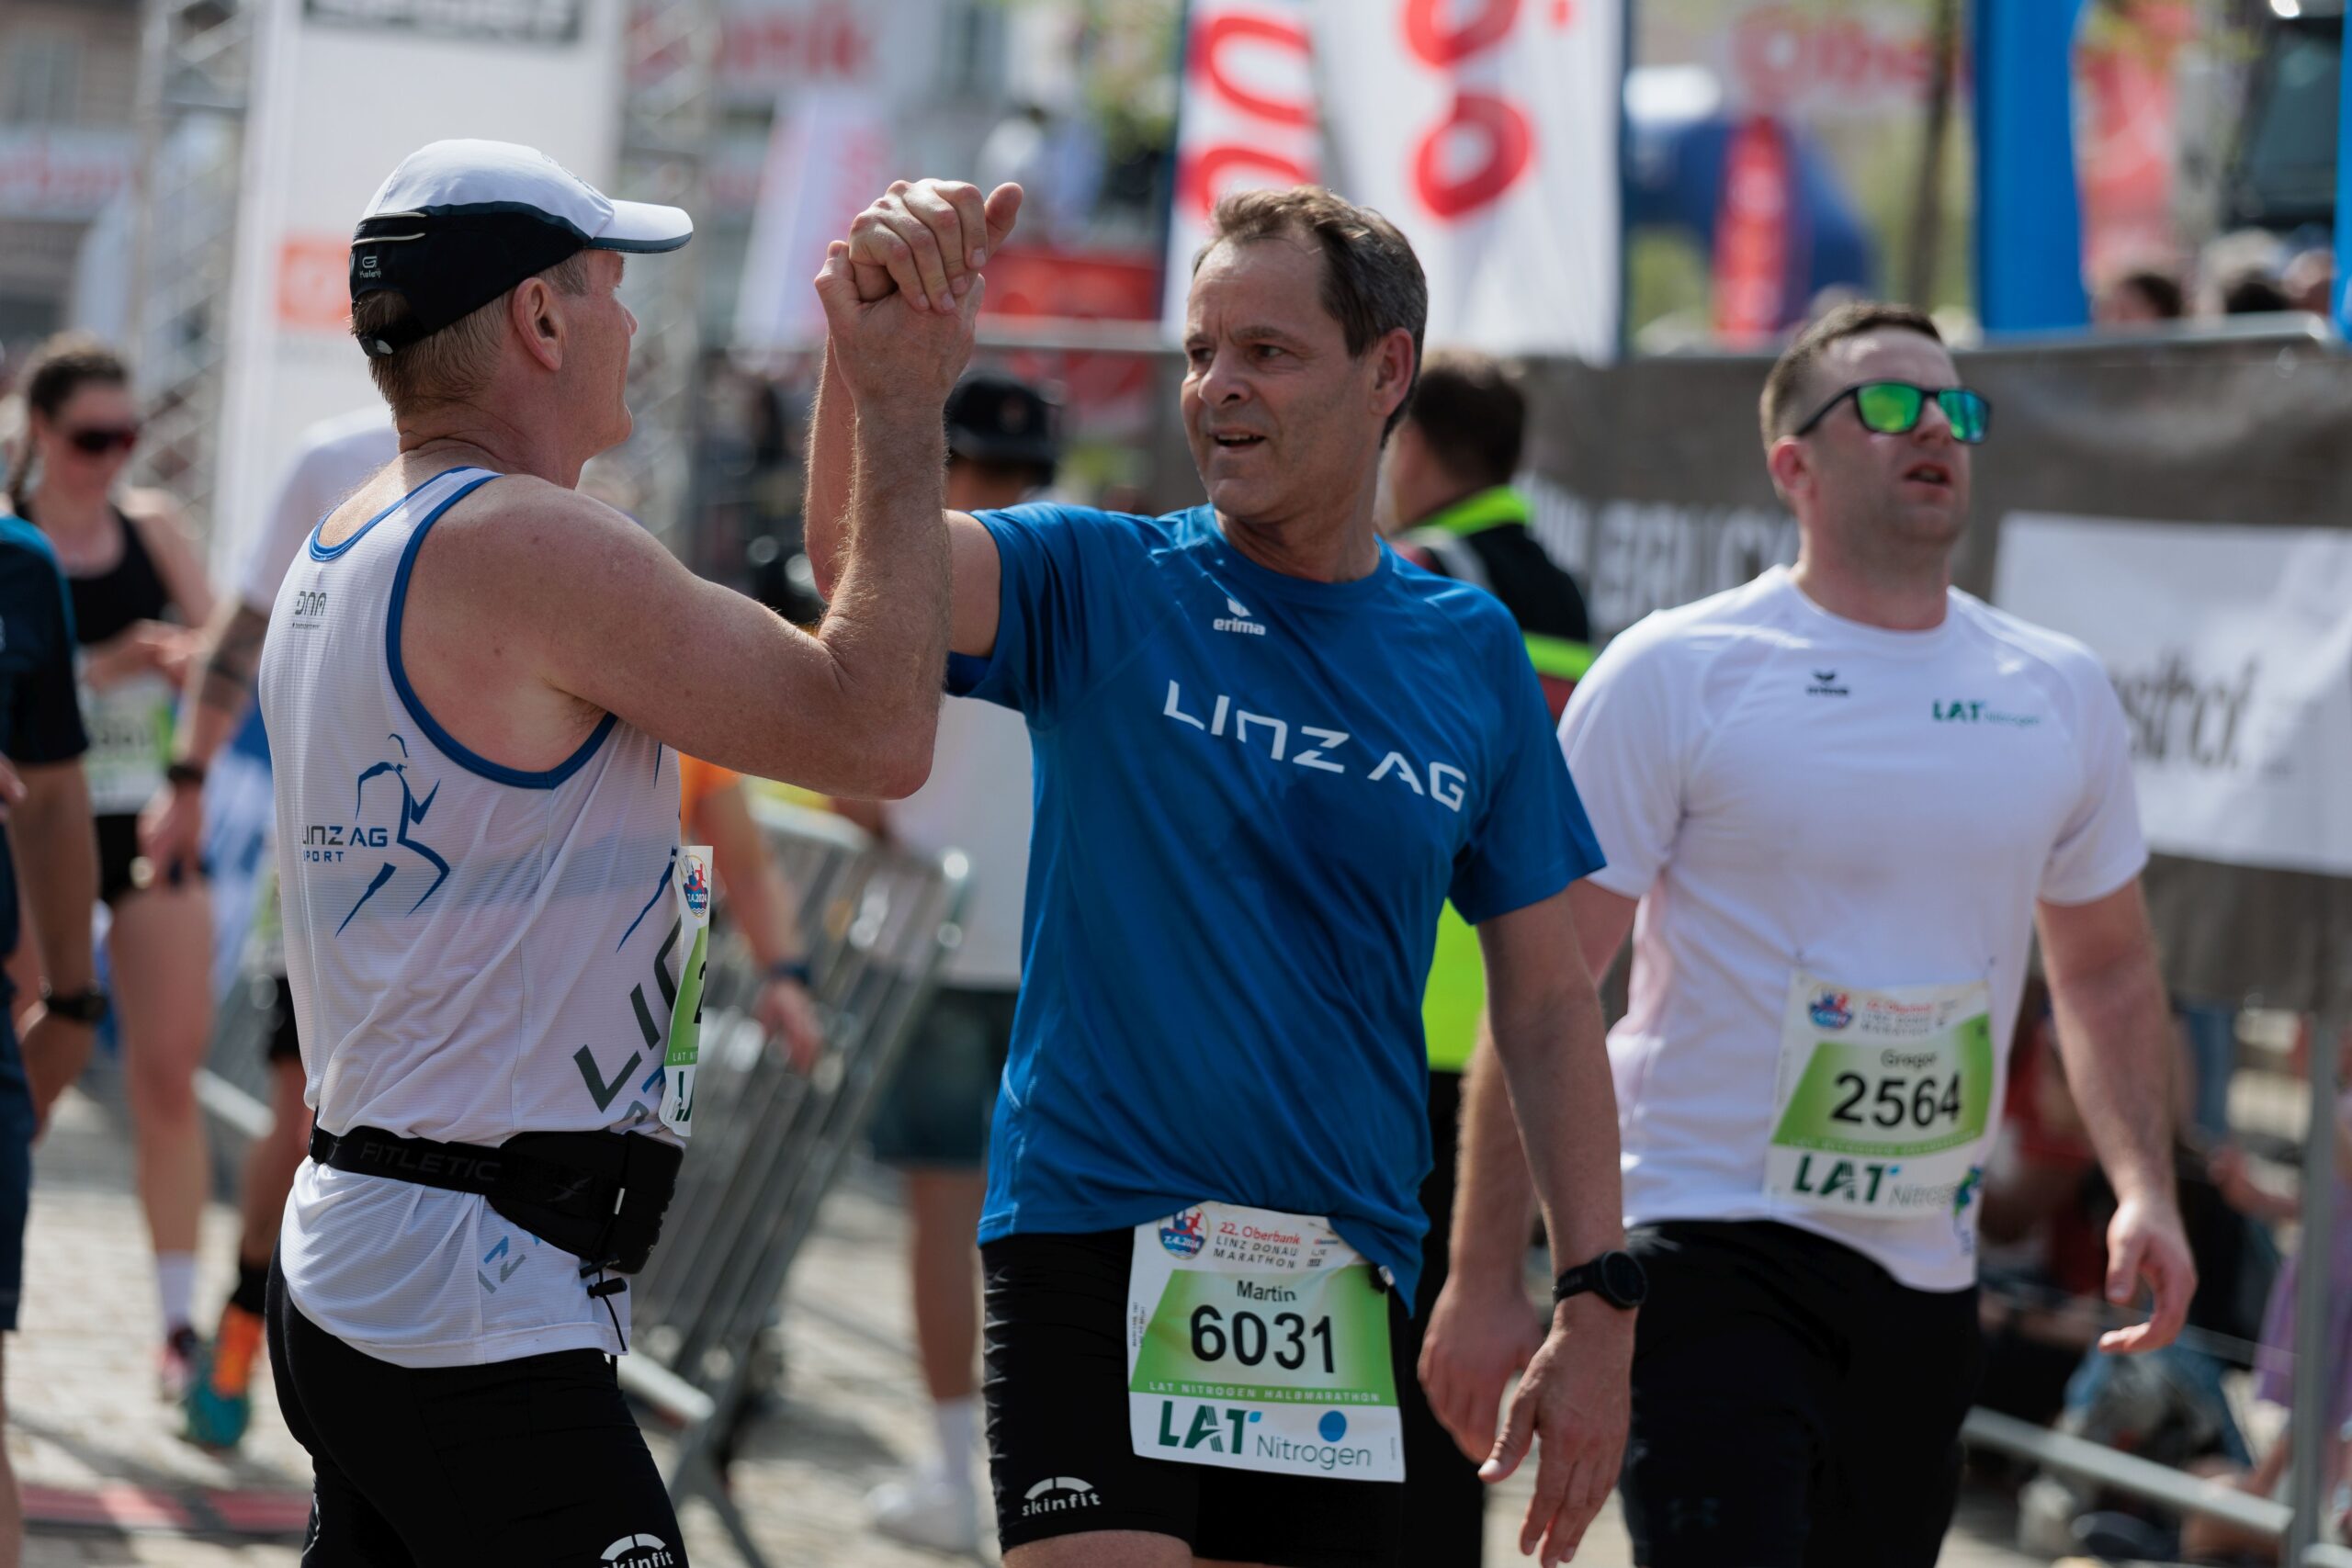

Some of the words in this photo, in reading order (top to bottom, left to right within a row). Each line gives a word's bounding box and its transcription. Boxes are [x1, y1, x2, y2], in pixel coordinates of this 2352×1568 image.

[1213, 617, 1267, 636] erima
[1932, 699, 1982, 722] LAT
[1163, 679, 1351, 773] LINZ
[1367, 750, 1468, 813] AG
[349, 826, 388, 847] AG
[303, 851, 344, 863] PORT
[1829, 1071, 1961, 1129] 2564
[359, 1142, 502, 1182] FITLETIC
[1793, 1154, 1885, 1203] LAT
[1219, 1222, 1239, 1235] 22.
[1242, 1225, 1302, 1245] Oberbank
[1216, 1235, 1248, 1250] LINZ
[1252, 1242, 1298, 1257] DONAU
[1213, 1248, 1296, 1269] MARATHON
[1237, 1280, 1297, 1302] Martin
[1190, 1304, 1335, 1374] 6031
[1148, 1381, 1174, 1392] LAT
[1181, 1384, 1257, 1399] NITROGEN
[1264, 1390, 1380, 1404] HALBMARATHON
[1158, 1400, 1250, 1455] LAT
[1256, 1434, 1373, 1470] Nitrogen
[1022, 1493, 1102, 1517] skinfit
[602, 1551, 673, 1568] infit
